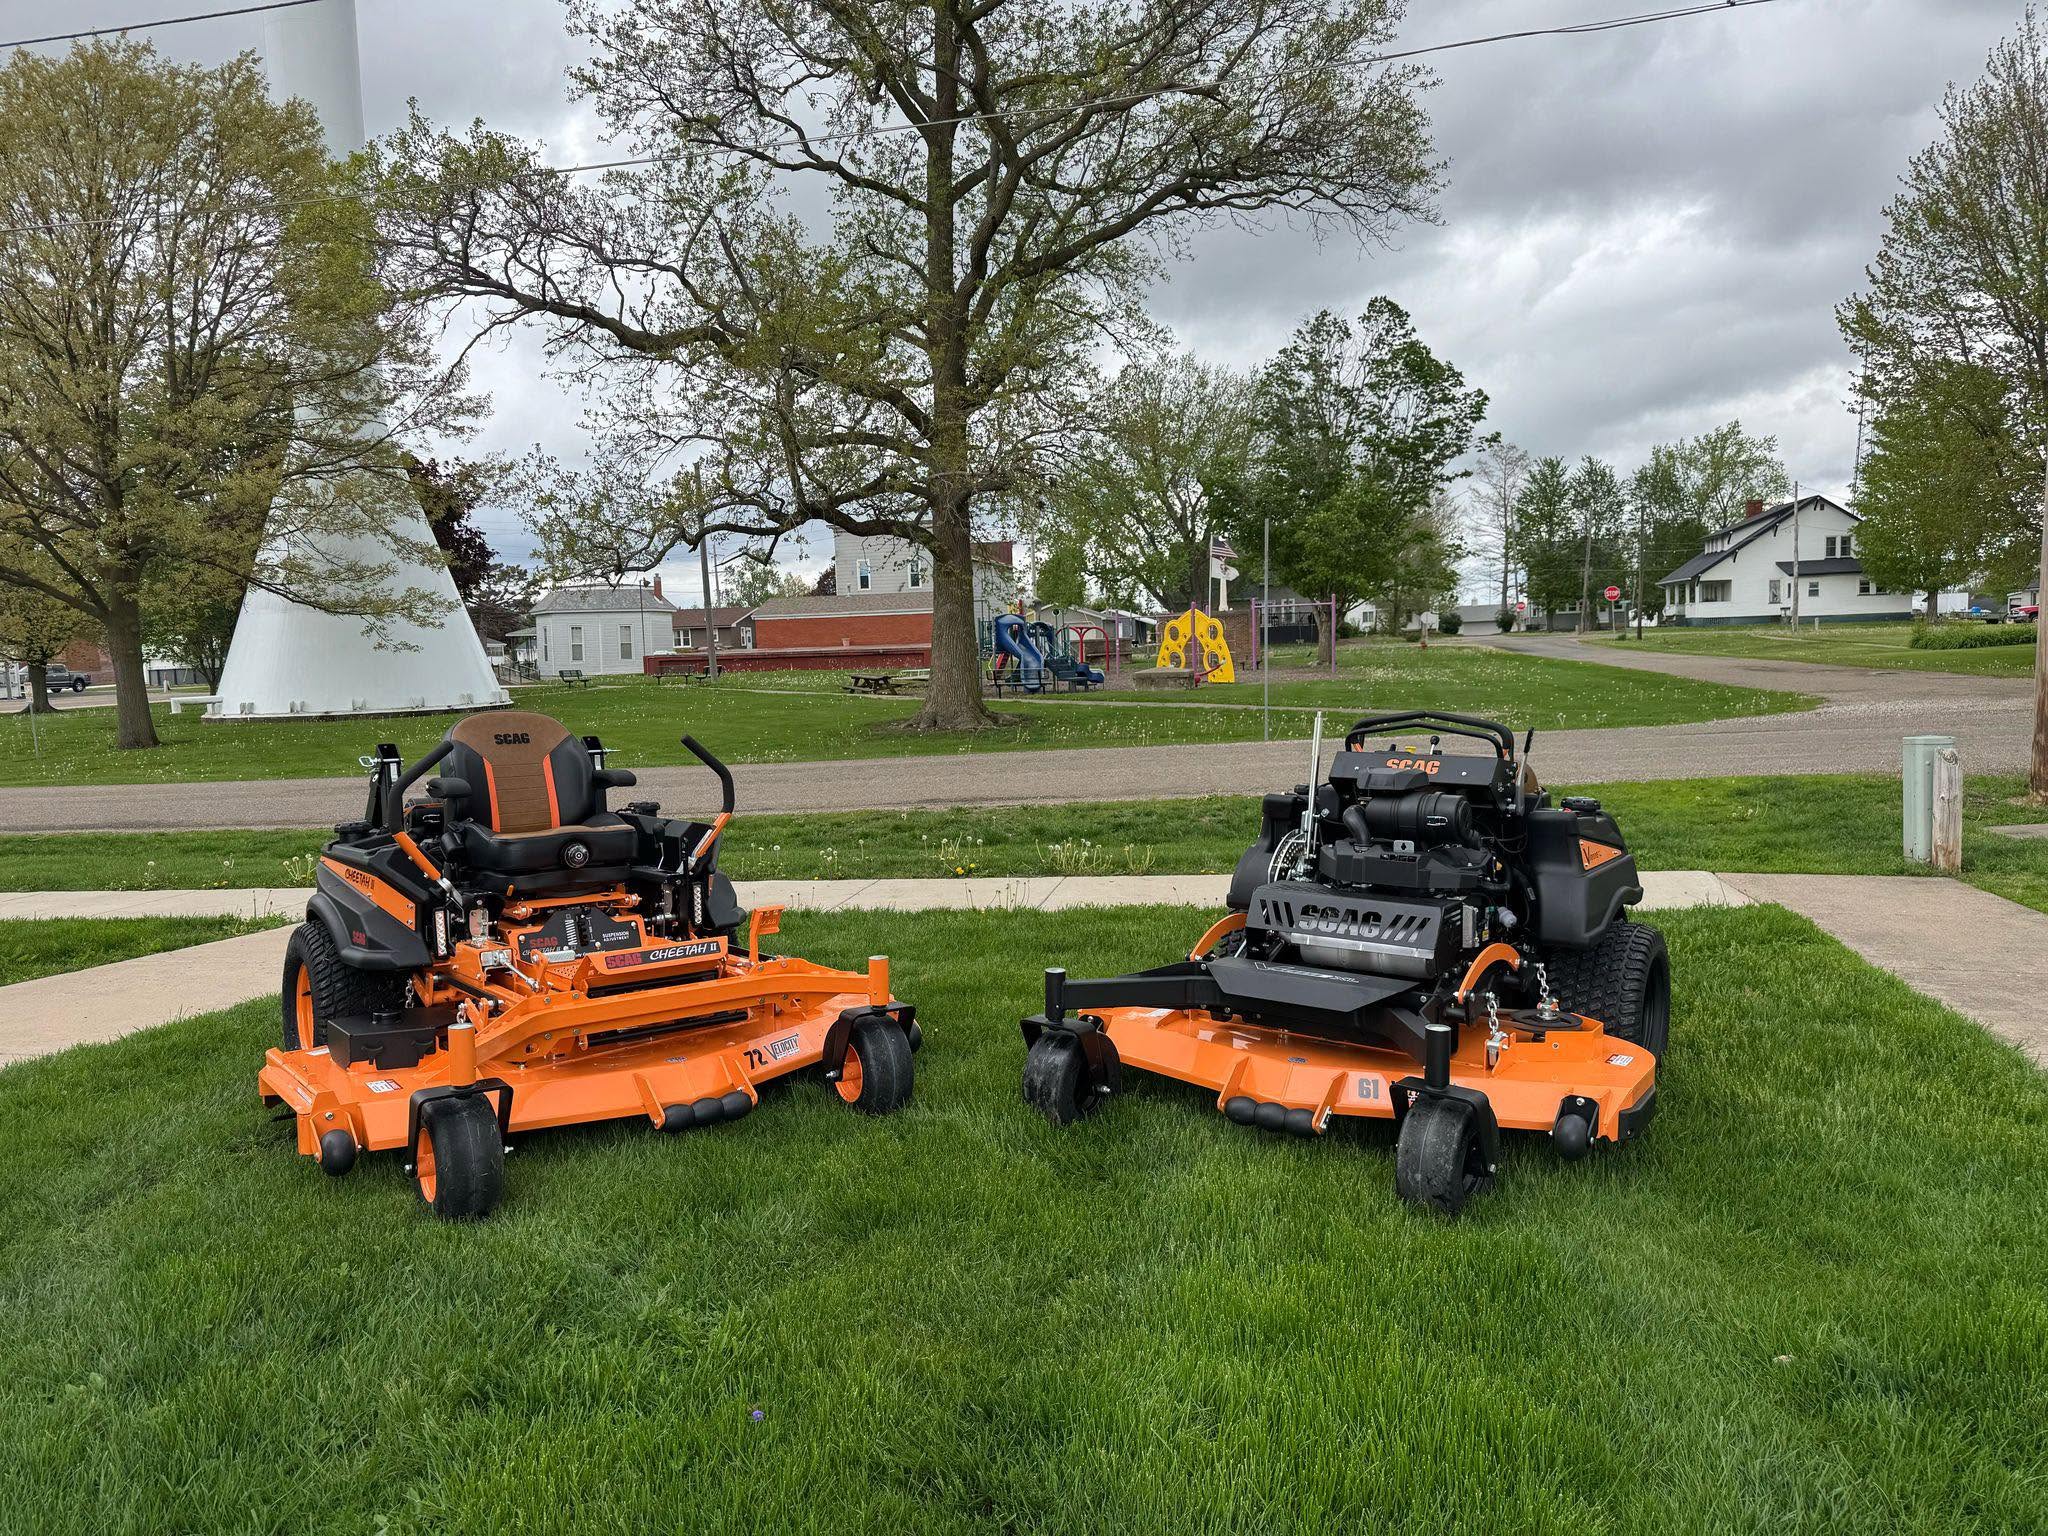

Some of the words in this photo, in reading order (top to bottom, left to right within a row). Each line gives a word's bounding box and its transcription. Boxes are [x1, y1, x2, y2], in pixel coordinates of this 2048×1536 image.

[494, 733, 530, 745] SCAG
[1386, 758, 1441, 775] SCAG
[345, 868, 371, 890] CHEETAH
[1299, 904, 1383, 938] SCAG
[606, 952, 641, 968] SCAG
[649, 943, 707, 960] CHEETAH
[709, 942, 717, 951] II
[743, 1048, 768, 1070] 72
[1358, 1078, 1379, 1099] 61
